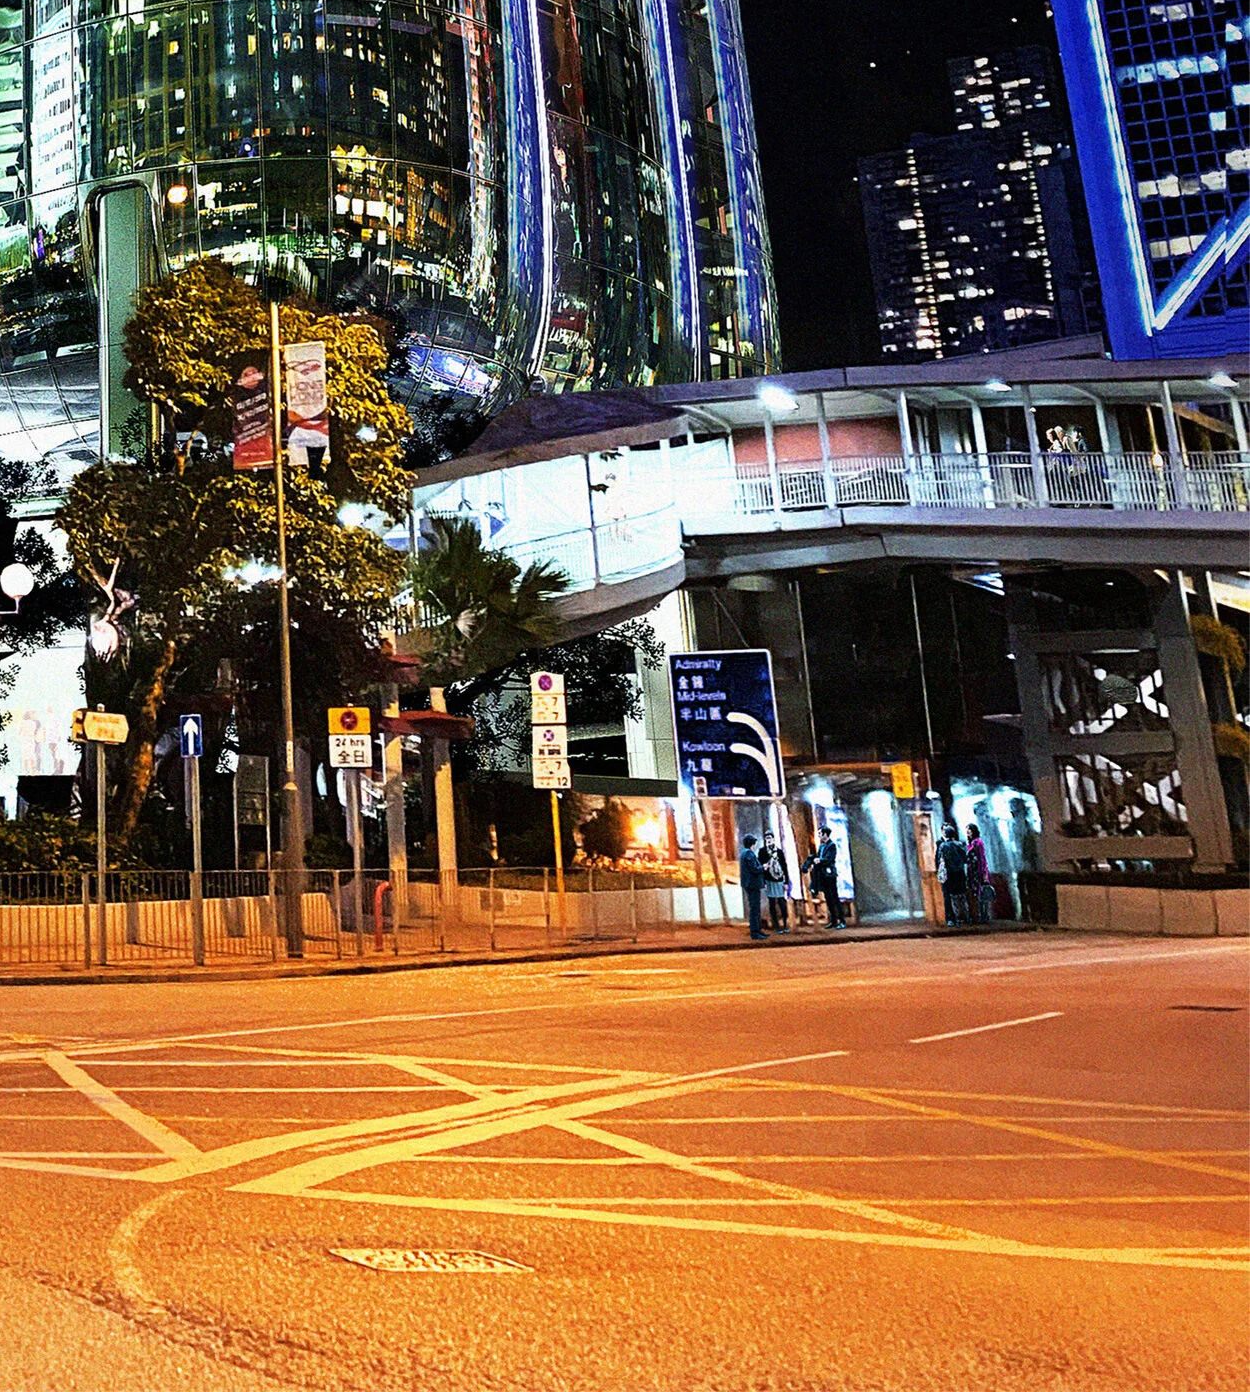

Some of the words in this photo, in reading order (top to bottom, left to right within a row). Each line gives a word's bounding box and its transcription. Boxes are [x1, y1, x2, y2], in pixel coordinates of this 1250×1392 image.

[675, 659, 722, 671] Admiralty
[677, 690, 727, 701] Mid-levels
[335, 738, 347, 747] 24
[350, 737, 365, 747] hrs
[682, 740, 726, 752] Kowloon
[338, 750, 365, 764] 全日
[686, 757, 713, 772] 九龍
[557, 777, 568, 786] 12
